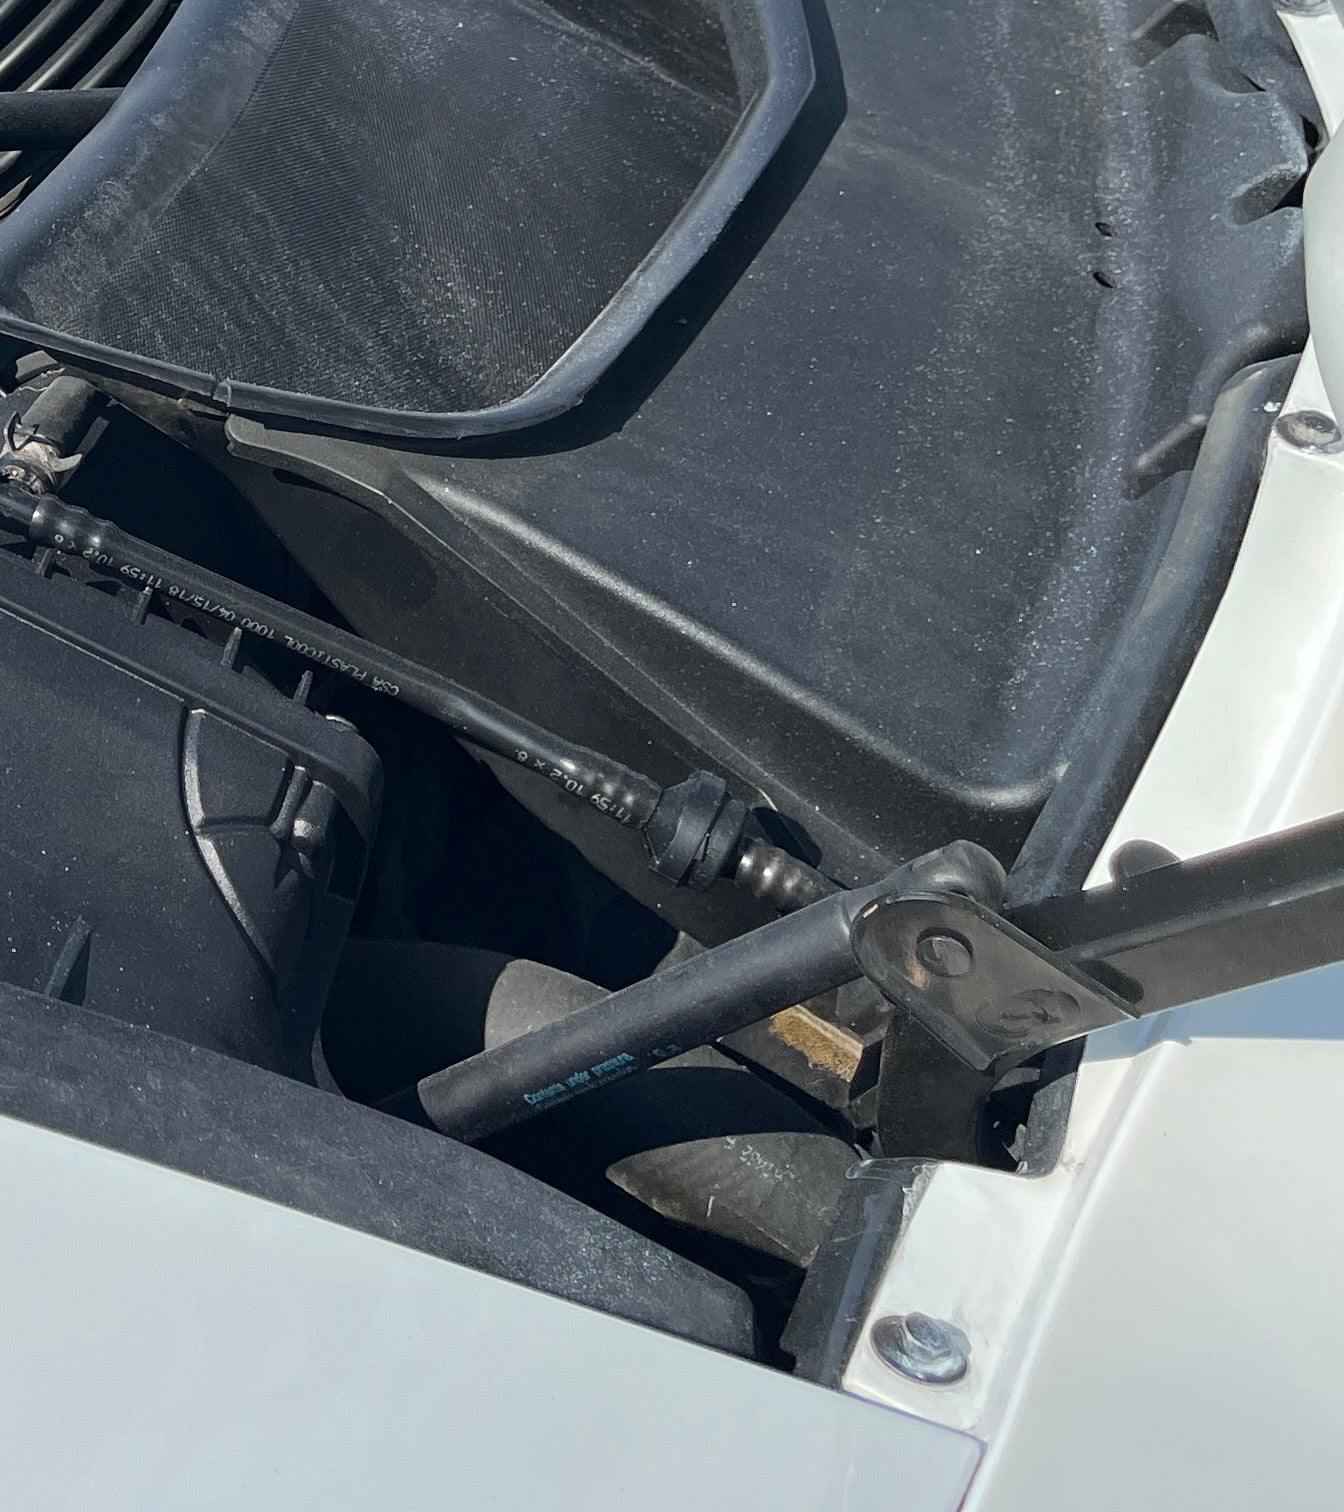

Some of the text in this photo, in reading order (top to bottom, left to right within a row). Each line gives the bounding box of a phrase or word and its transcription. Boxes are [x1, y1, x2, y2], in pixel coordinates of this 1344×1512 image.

[120, 565, 162, 588] 11:59
[168, 585, 235, 621] 04/15/18
[241, 618, 274, 639] 1000
[550, 768, 584, 795] 10.2
[590, 793, 631, 823] 11:59
